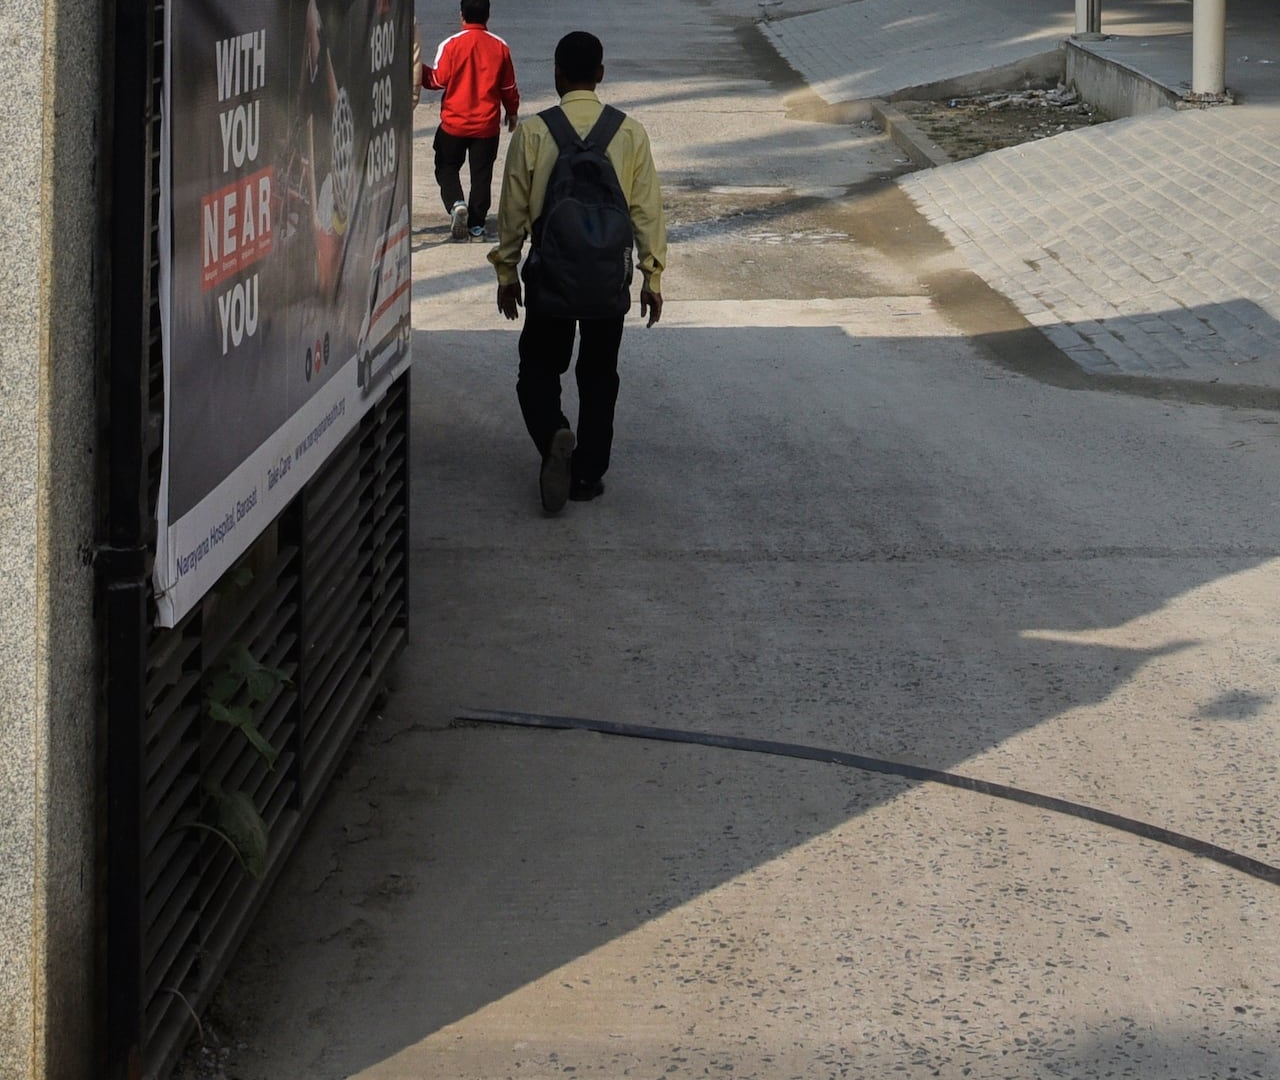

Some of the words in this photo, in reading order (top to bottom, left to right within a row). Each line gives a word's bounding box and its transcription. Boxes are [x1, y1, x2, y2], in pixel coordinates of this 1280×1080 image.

[215, 28, 266, 103] WITH
[370, 19, 395, 73] 1800
[219, 99, 261, 174] YOU
[372, 74, 393, 129] 309
[366, 128, 397, 188] 0309
[203, 175, 271, 268] NEAR
[218, 272, 259, 356] YOU
[176, 537, 209, 577] Narayana
[210, 508, 236, 550] Hospital,
[236, 487, 258, 523] Barasat
